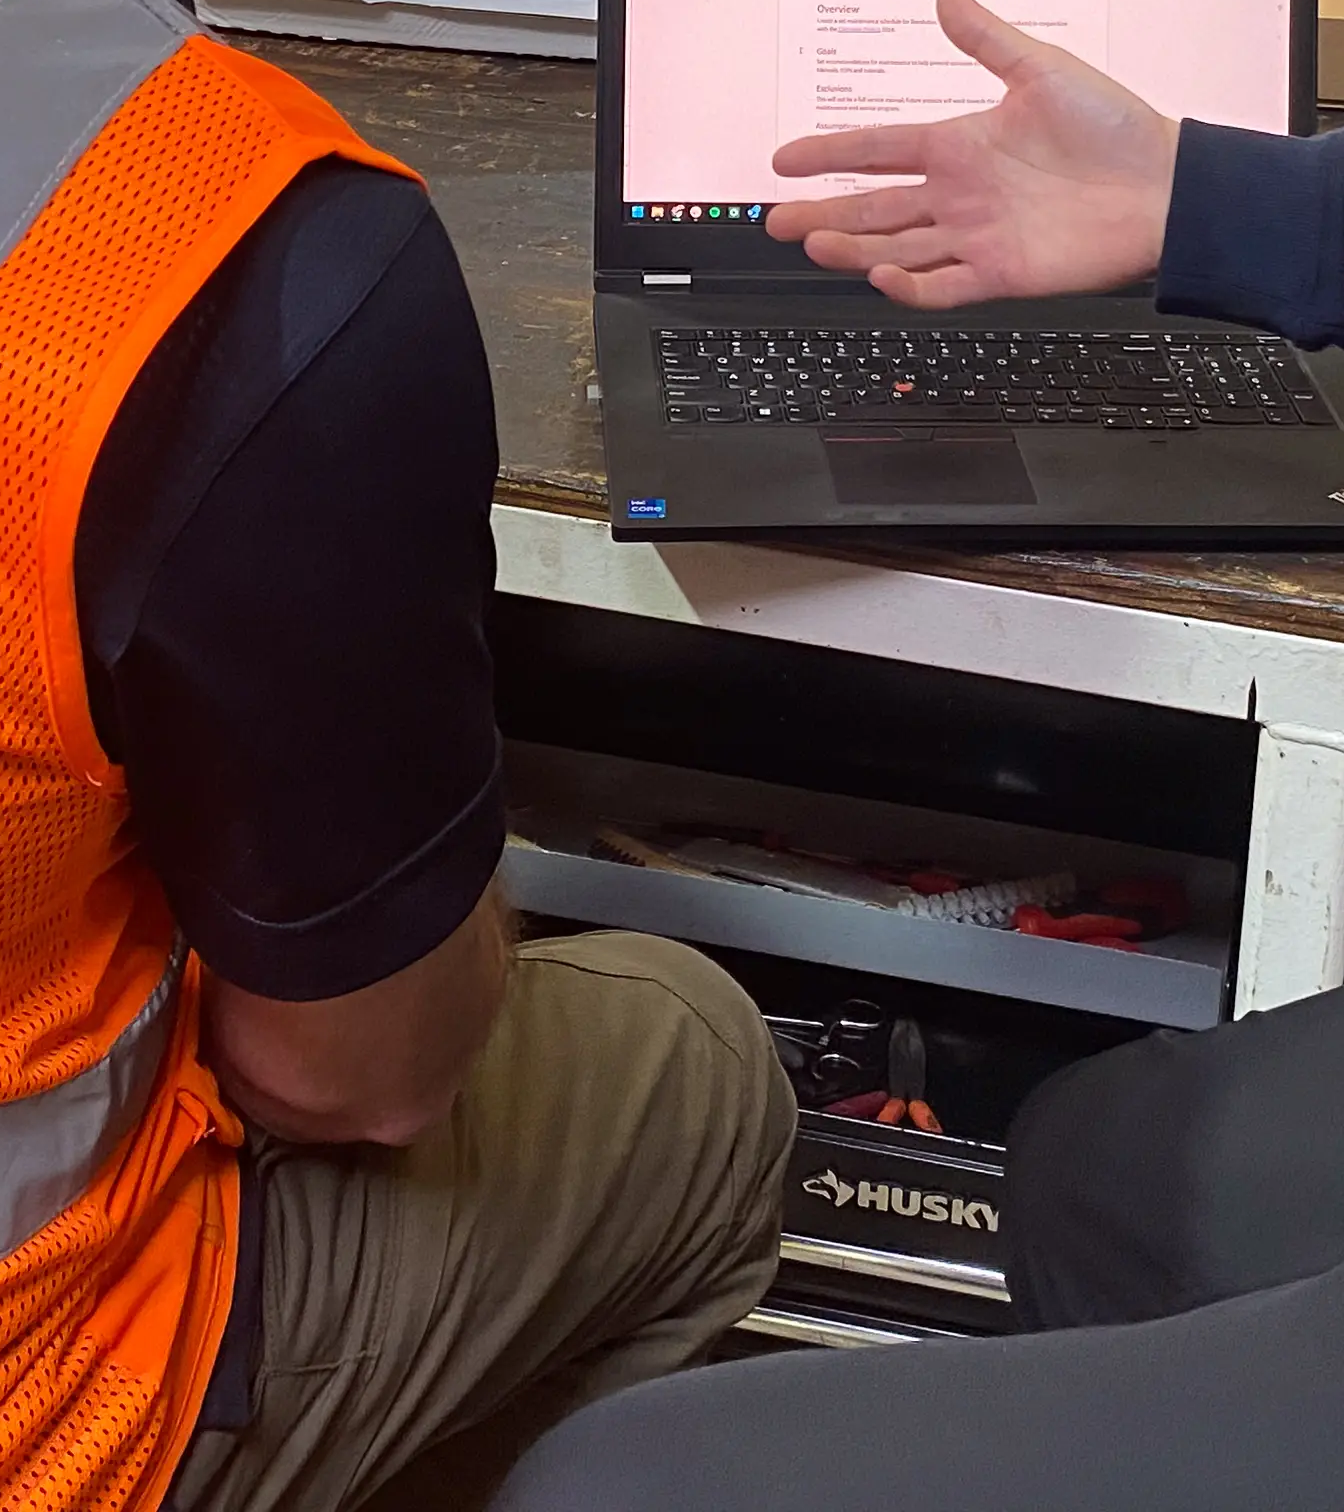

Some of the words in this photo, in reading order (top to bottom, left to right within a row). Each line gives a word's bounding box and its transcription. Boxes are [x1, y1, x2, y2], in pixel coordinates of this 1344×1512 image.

[817, 5, 860, 14] Overview
[816, 47, 837, 56] Goals
[816, 85, 853, 93] Exclusions
[857, 1180, 1000, 1233] HUSKY
